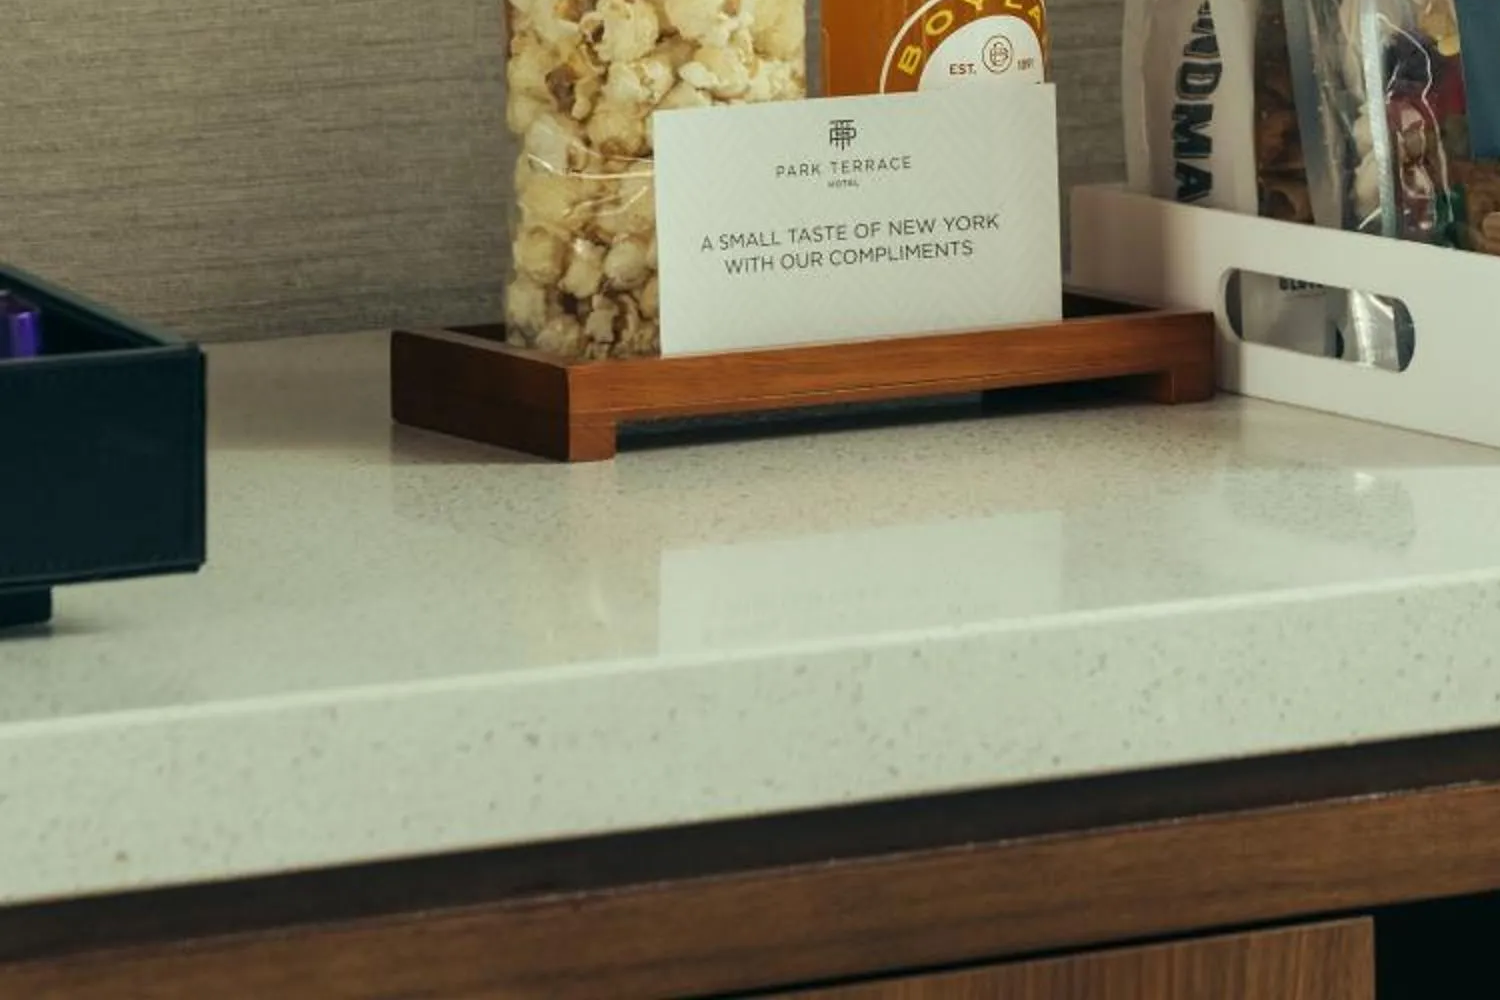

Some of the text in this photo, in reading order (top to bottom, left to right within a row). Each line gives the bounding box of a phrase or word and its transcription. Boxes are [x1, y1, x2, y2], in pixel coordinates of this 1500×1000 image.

[949, 63, 977, 75] EST.
[775, 156, 912, 178] PARK TERRACE
[827, 179, 860, 188] HOTEL
[701, 213, 1000, 252] A SMALL TASTE OF NEW YORK
[723, 239, 974, 275] WITH OUR COMPLIMENTS
